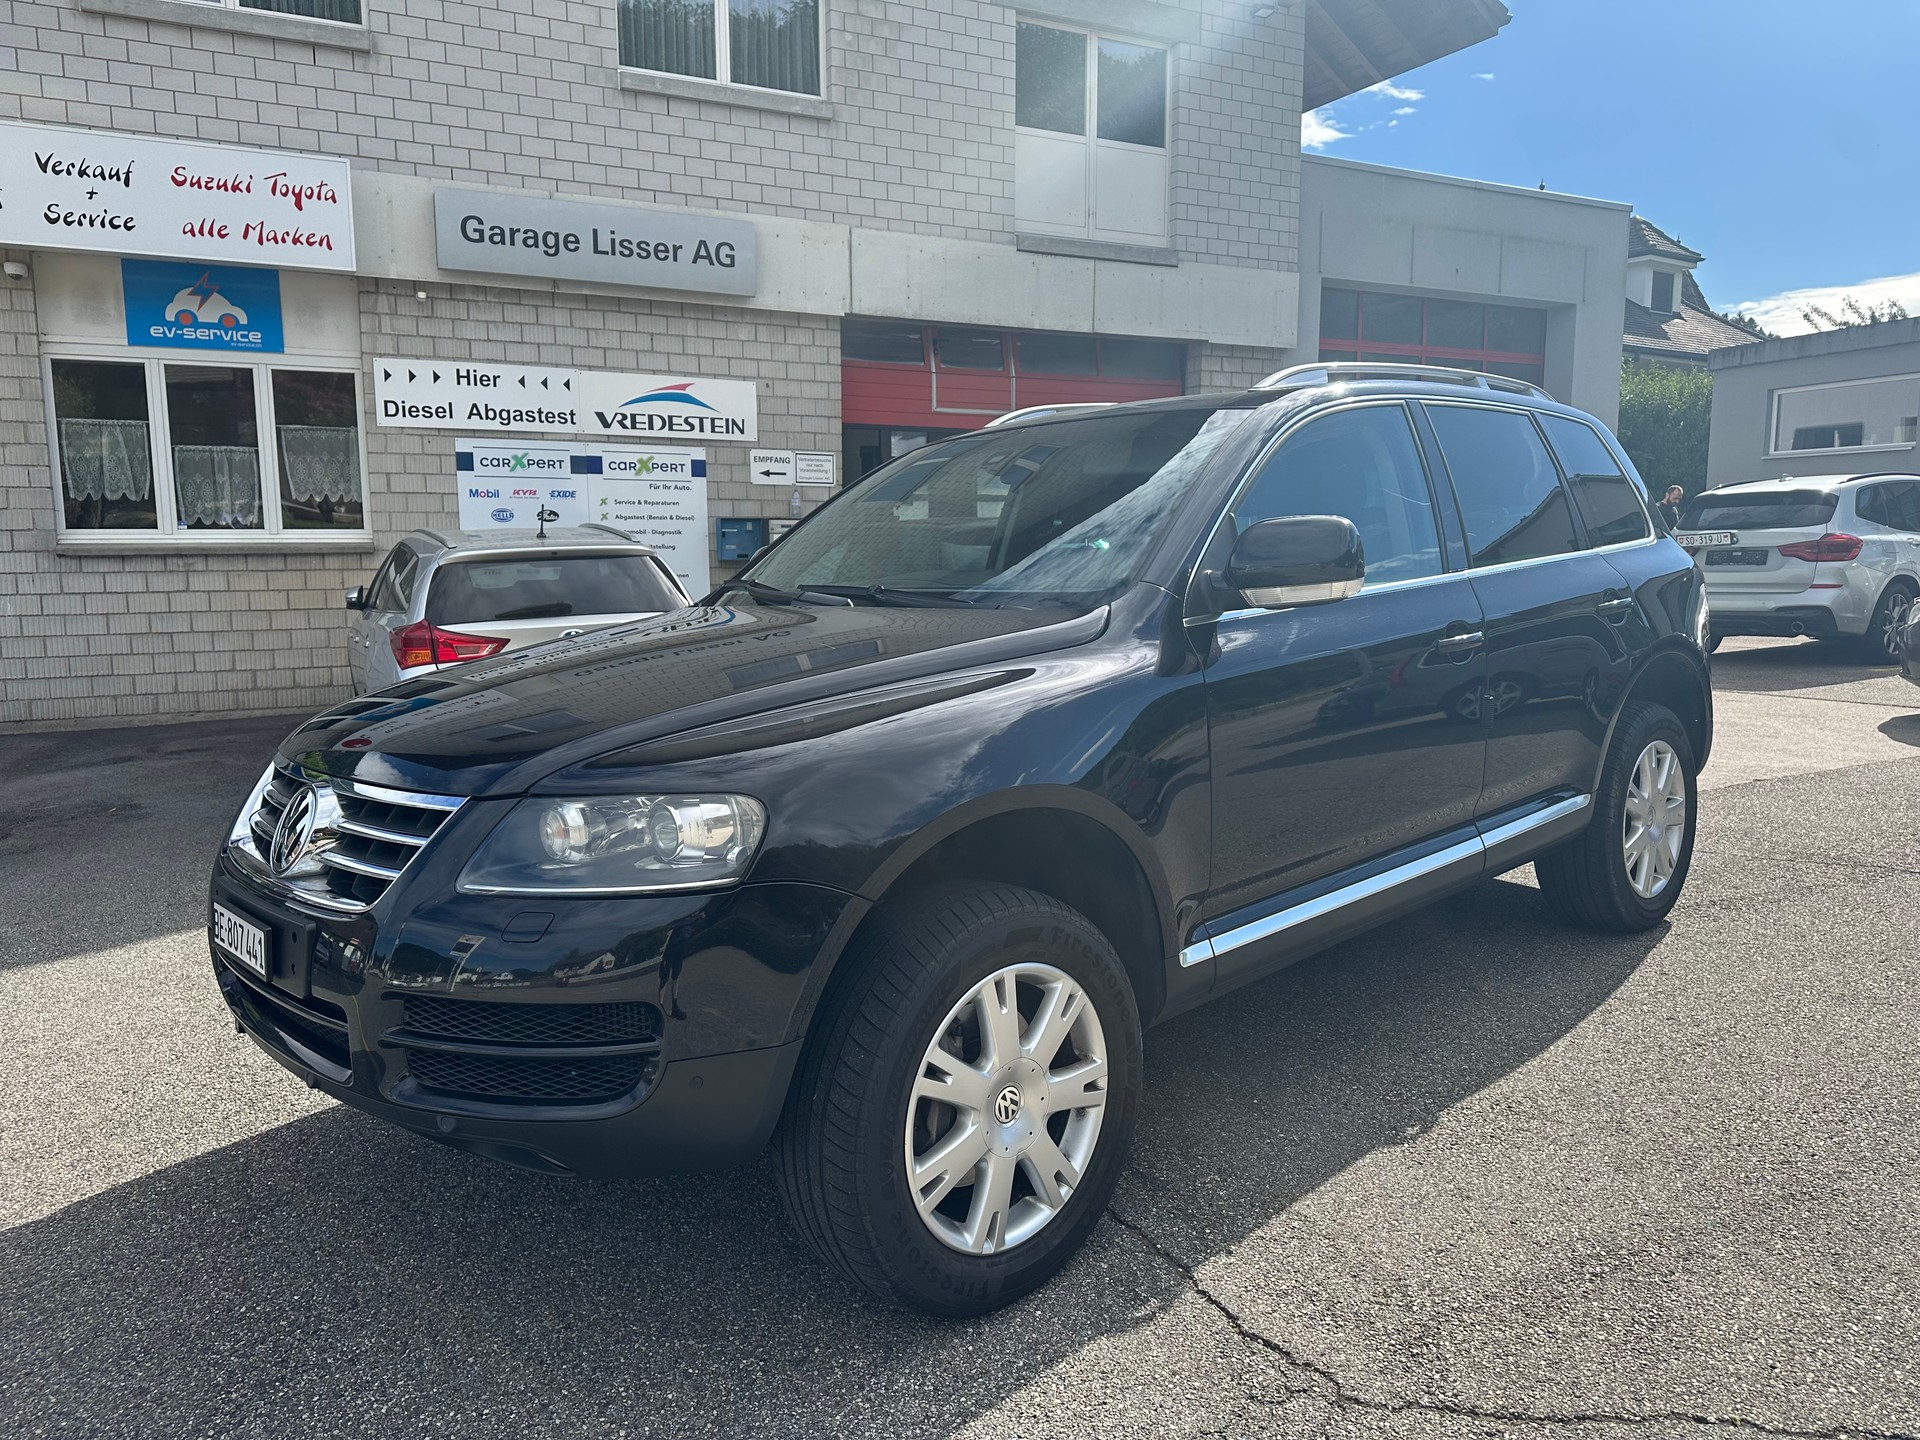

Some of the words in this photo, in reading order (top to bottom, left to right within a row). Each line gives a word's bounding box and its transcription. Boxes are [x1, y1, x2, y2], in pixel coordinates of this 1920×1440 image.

[34, 151, 136, 188] Verkauf
[86, 187, 99, 200] +
[170, 166, 253, 195] Suzuki
[264, 172, 338, 212] Toyota
[43, 203, 137, 232] Service
[182, 218, 230, 240] alle
[243, 220, 333, 251] Marken
[460, 214, 581, 257] Garage
[592, 228, 683, 262] Lisser
[691, 239, 736, 268] AG
[150, 325, 262, 343] ev-service
[455, 368, 501, 388] Hier
[383, 400, 454, 420] Diesel
[467, 402, 577, 426] Abgastest
[594, 411, 746, 436] VREDESTEIN
[753, 456, 791, 464] EMPFANG
[469, 489, 500, 498] Mobil
[549, 490, 577, 498] EXIDE
